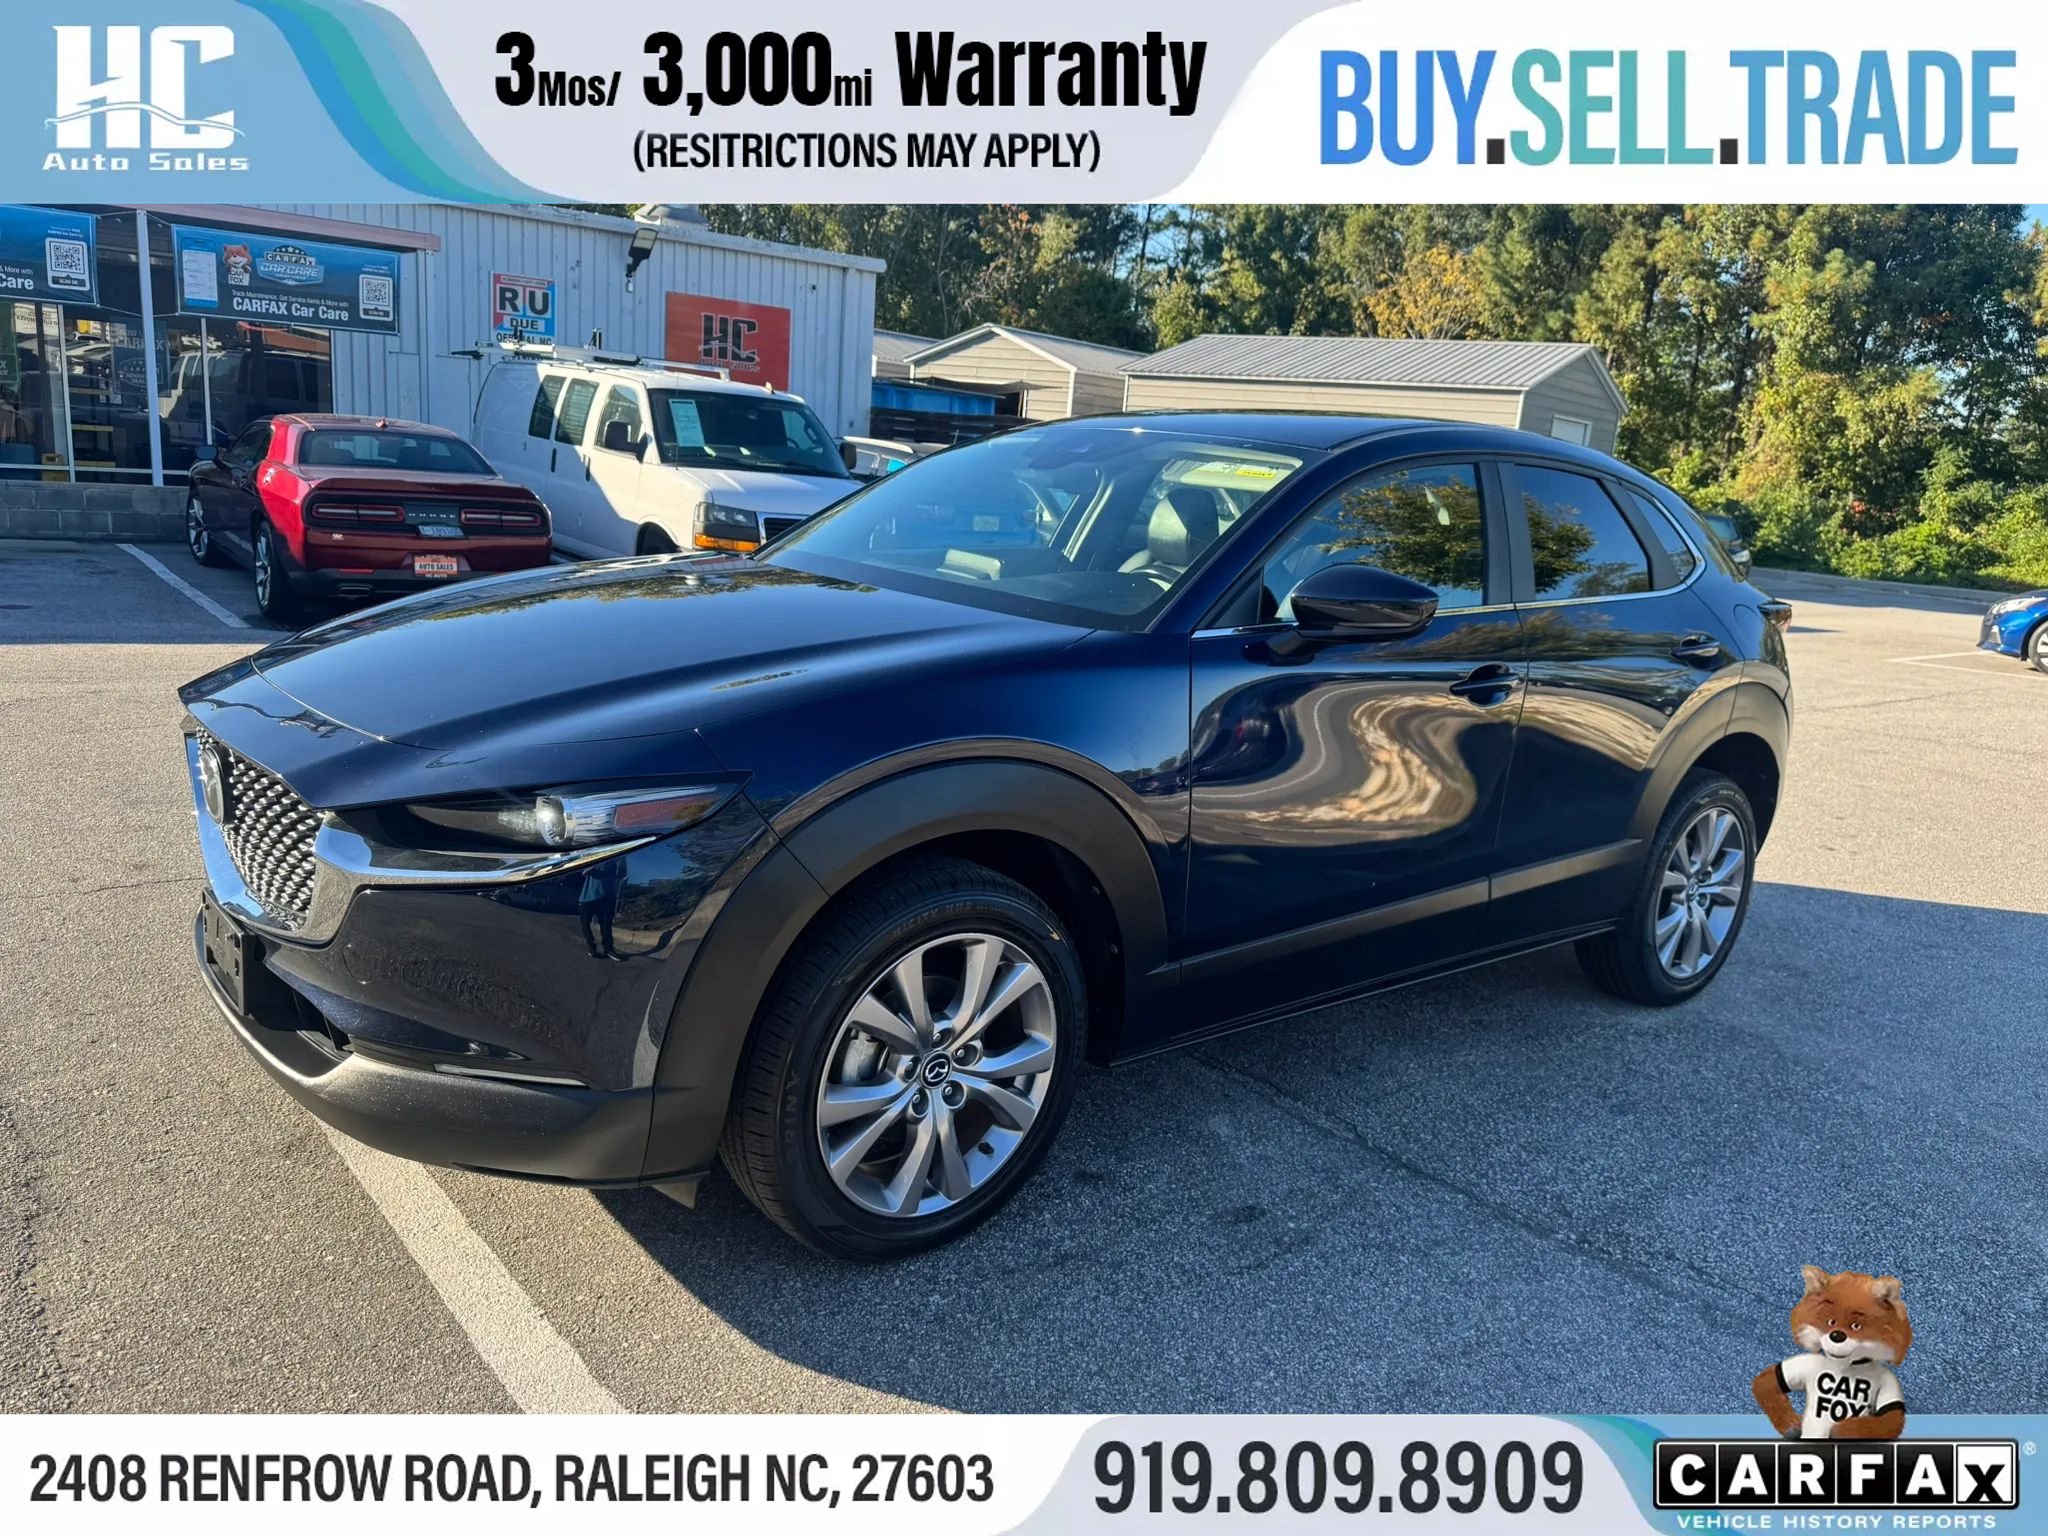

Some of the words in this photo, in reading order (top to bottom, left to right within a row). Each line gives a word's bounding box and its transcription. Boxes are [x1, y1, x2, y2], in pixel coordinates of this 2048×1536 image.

[265, 252, 316, 267] CARFAX
[0, 273, 34, 290] Care
[229, 276, 244, 285] FOX
[233, 296, 288, 315] CARFAX
[291, 302, 315, 317] Car
[318, 305, 349, 321] Care
[510, 318, 540, 331] DUE
[700, 312, 759, 364] HC
